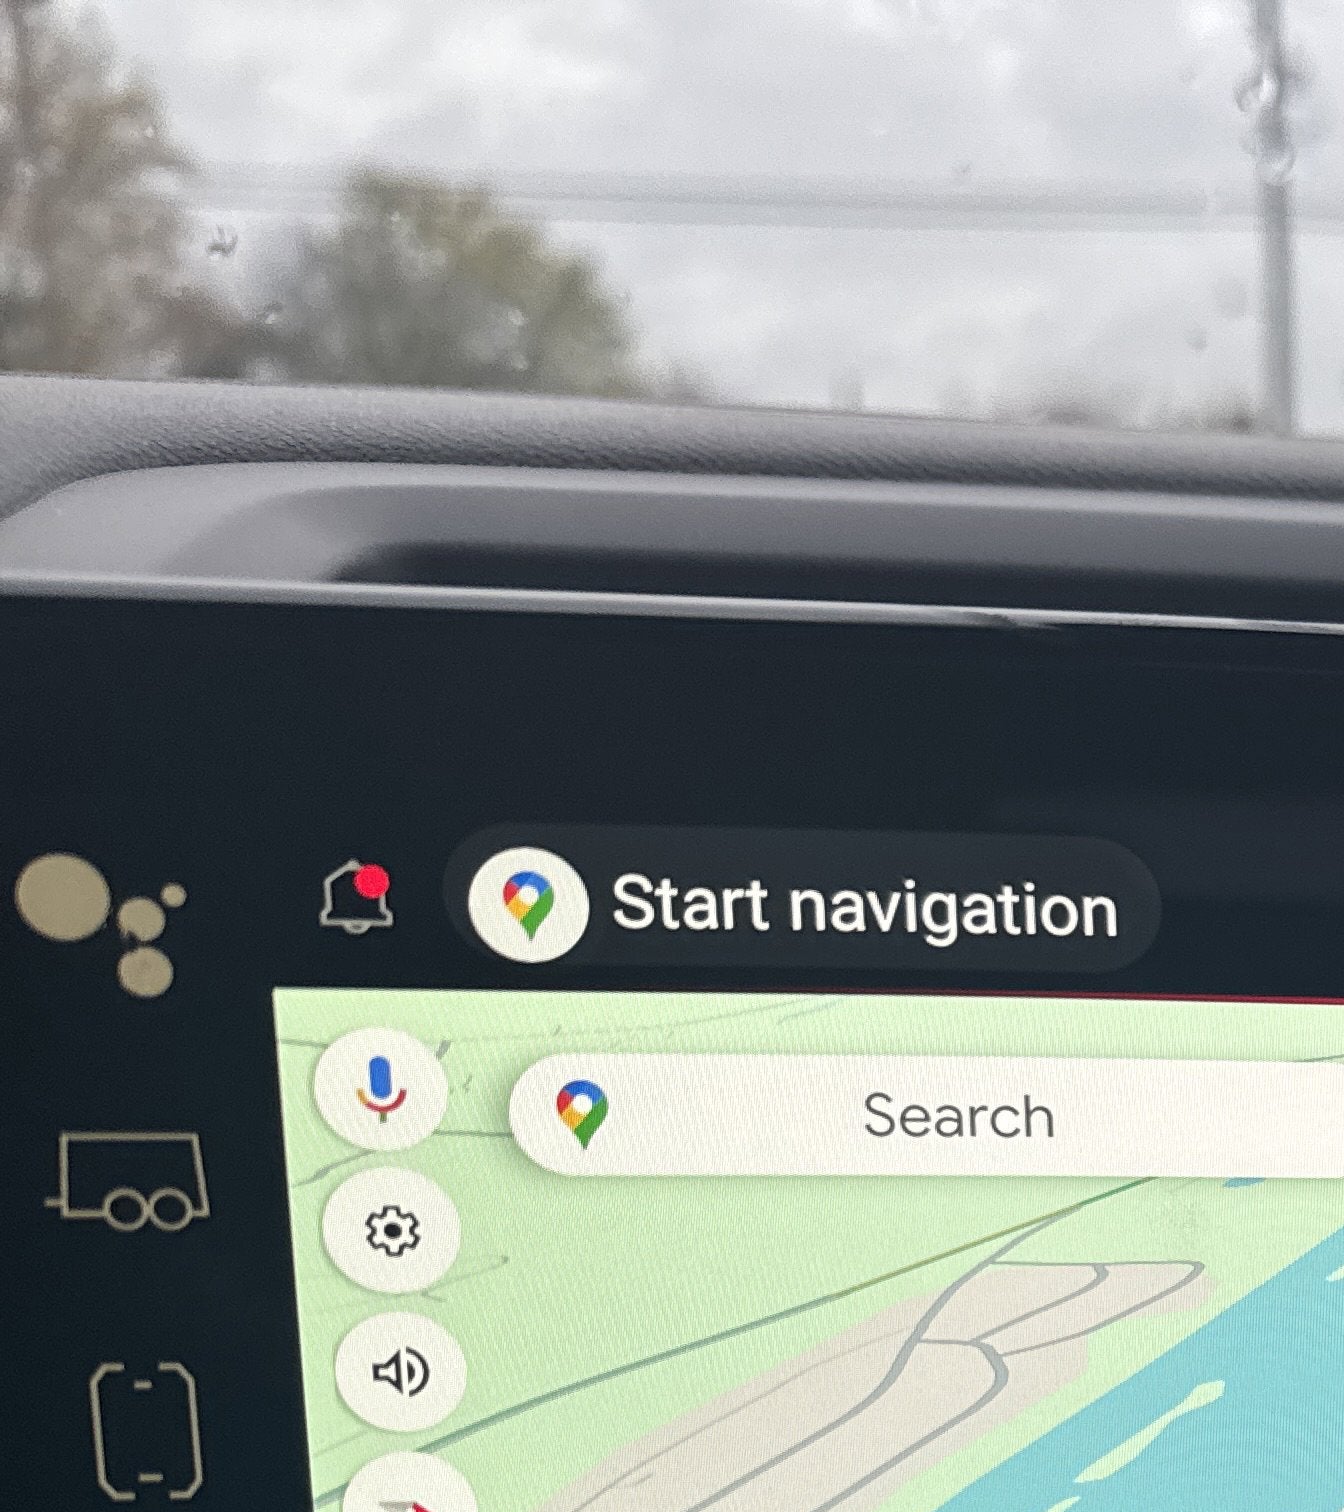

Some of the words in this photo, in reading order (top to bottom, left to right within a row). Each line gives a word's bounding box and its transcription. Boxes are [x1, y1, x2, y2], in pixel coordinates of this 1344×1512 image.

[612, 871, 771, 933] Start
[789, 878, 1119, 949] navigation
[863, 1091, 1055, 1140] Search
